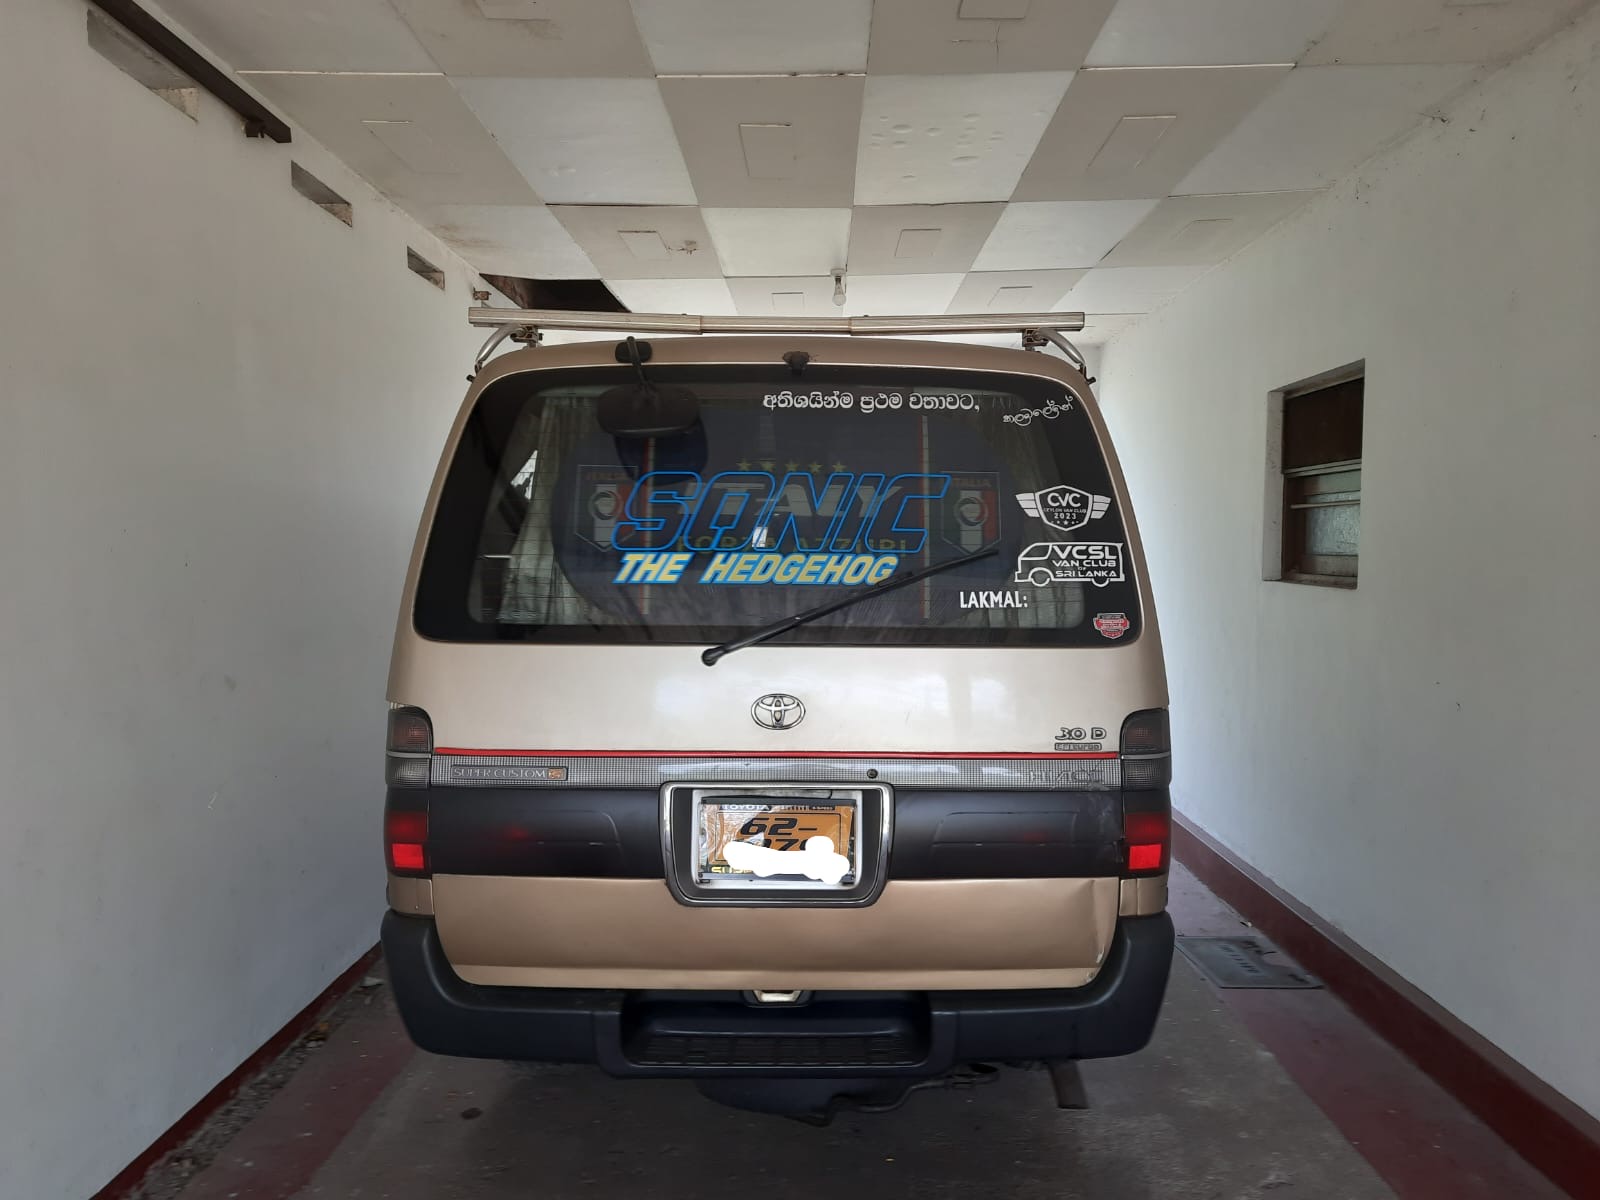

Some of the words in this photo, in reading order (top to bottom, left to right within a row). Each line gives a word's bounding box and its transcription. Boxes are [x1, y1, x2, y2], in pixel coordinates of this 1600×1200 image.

[763, 390, 854, 412] අතිශයින්ම
[1047, 492, 1081, 507] CVC
[611, 470, 952, 553] SONIC
[1054, 512, 1077, 520] 2023
[1052, 545, 1117, 560] VCSL
[613, 552, 695, 585] THE
[699, 552, 900, 586] HEDGEHOG
[1052, 559, 1079, 567] VAN
[1082, 559, 1117, 567] CLUB
[959, 590, 1028, 609] LAKMAL:
[1090, 727, 1107, 740] D
[454, 766, 491, 778] SUPER
[493, 766, 546, 778] CUSTOM
